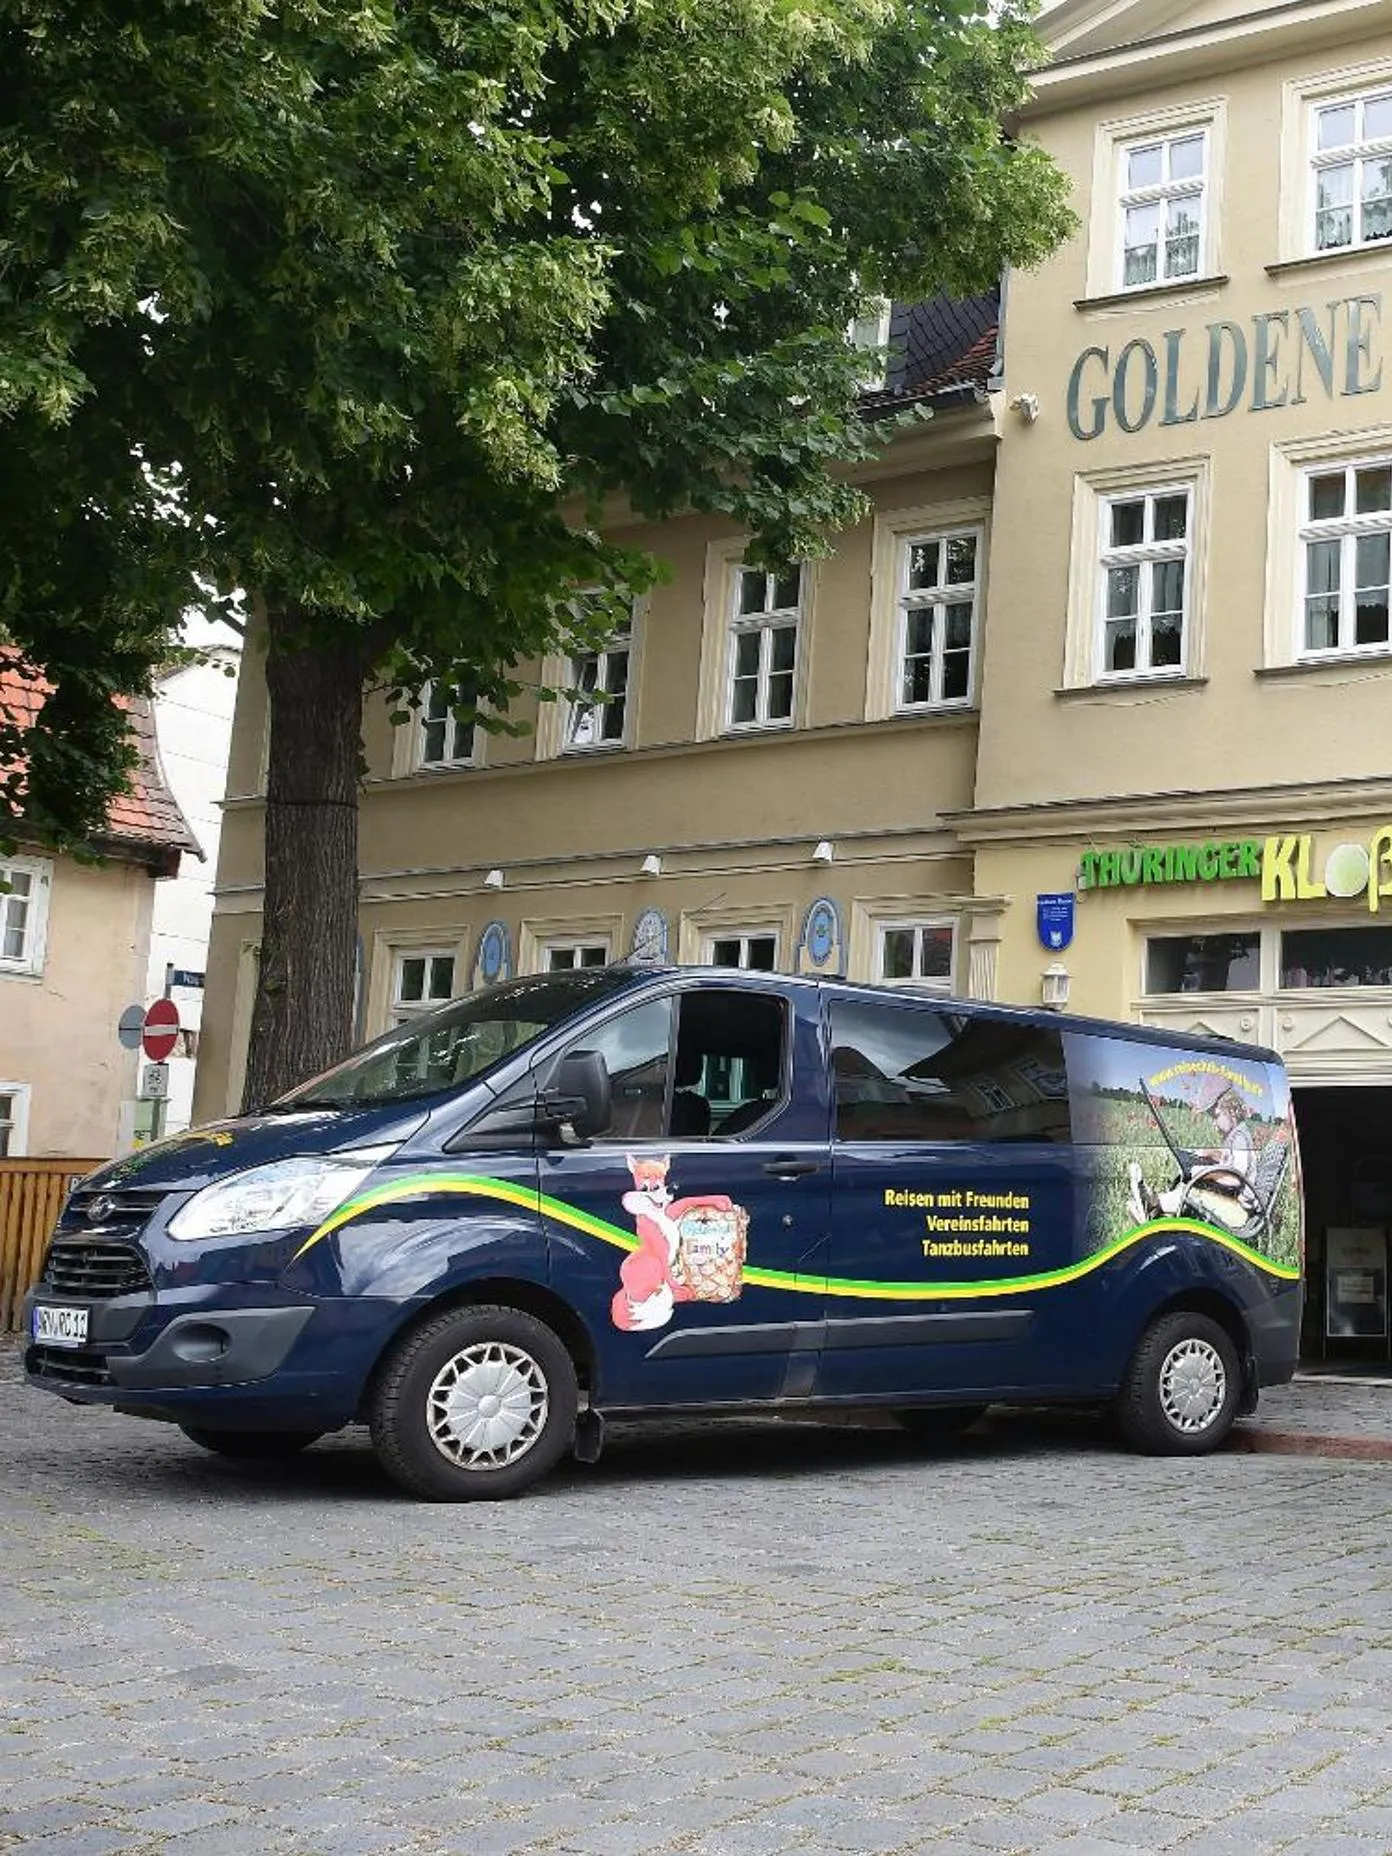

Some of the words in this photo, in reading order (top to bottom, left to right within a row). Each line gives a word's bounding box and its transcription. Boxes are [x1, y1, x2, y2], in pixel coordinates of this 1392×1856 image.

[1066, 292, 1382, 441] GOLDENE
[1080, 837, 1264, 891] THÜRINGER
[884, 1189, 934, 1208] Reisen
[937, 1190, 962, 1208] mit
[966, 1190, 1030, 1209] Freunden
[926, 1215, 1030, 1233] Vereinsfahrten
[922, 1239, 1030, 1257] Tanzbusfahrten
